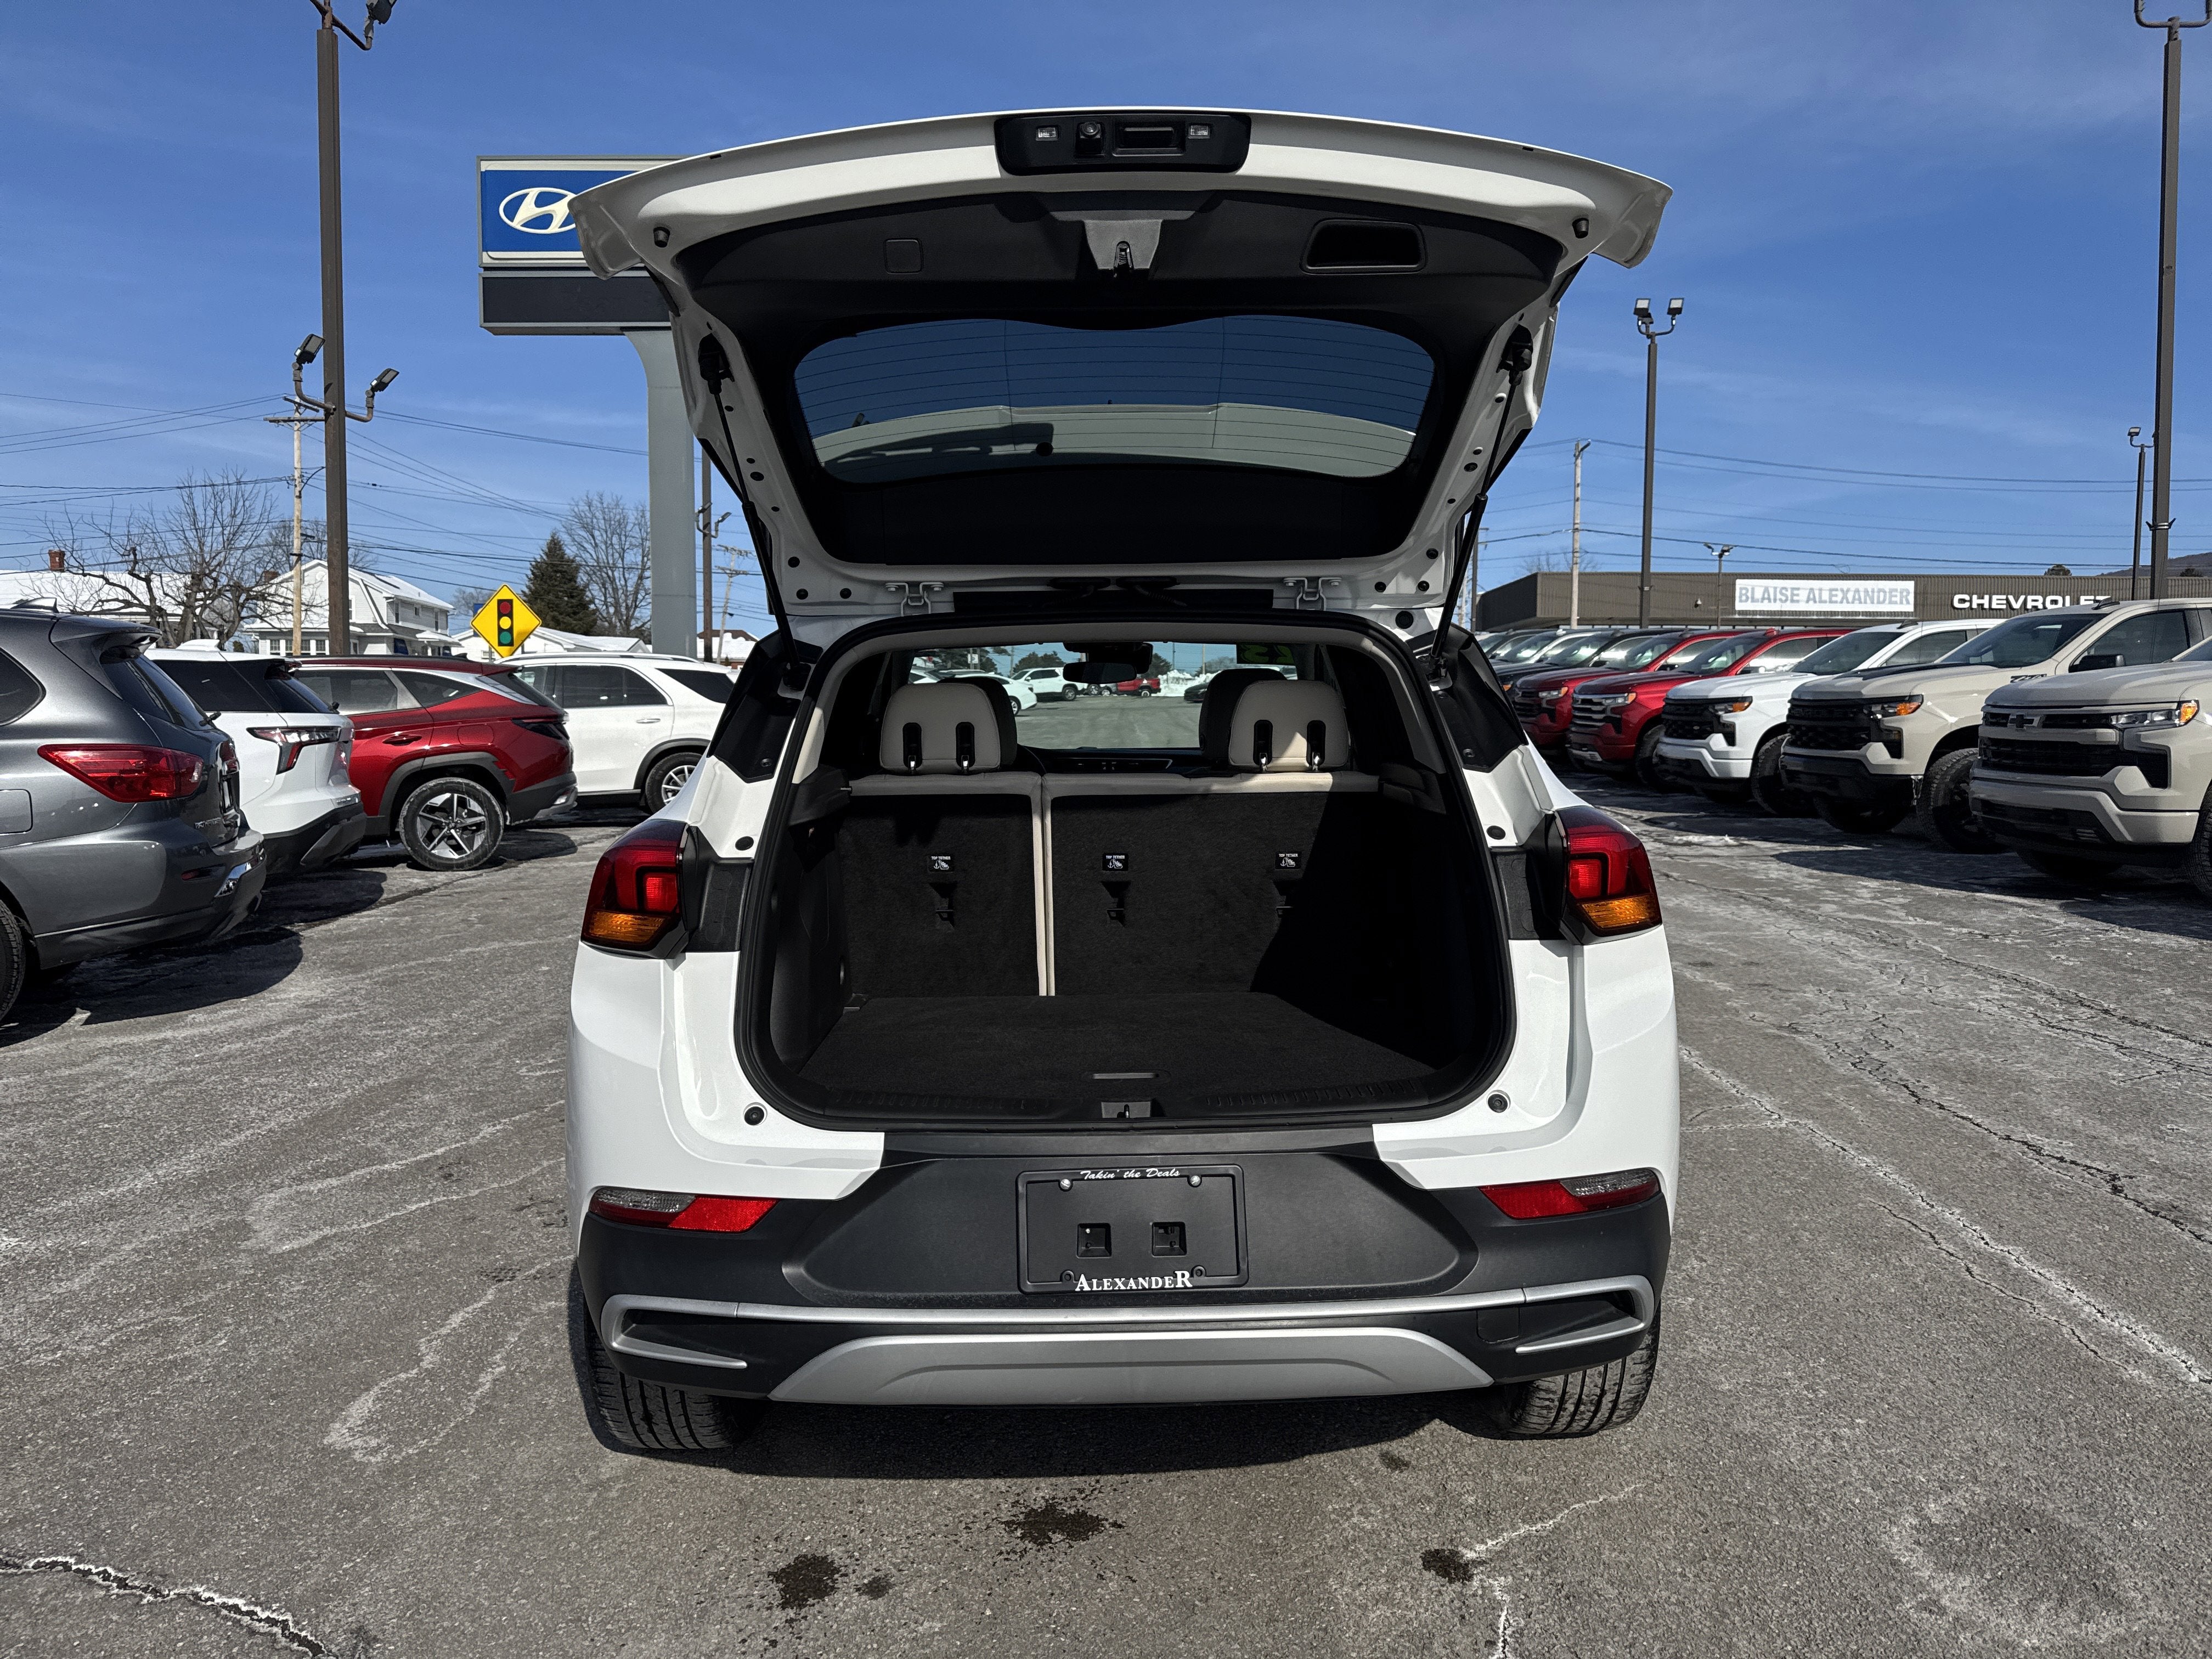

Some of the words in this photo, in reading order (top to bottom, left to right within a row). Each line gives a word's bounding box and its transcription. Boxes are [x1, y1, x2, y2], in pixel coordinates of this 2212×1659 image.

[1739, 587, 1800, 603] BLAISE
[1805, 588, 1911, 605] ALEXANDER
[1123, 1169, 1141, 1178] the
[1146, 1167, 1181, 1177] Deals
[1075, 1271, 1193, 1291] ALEXANDER
